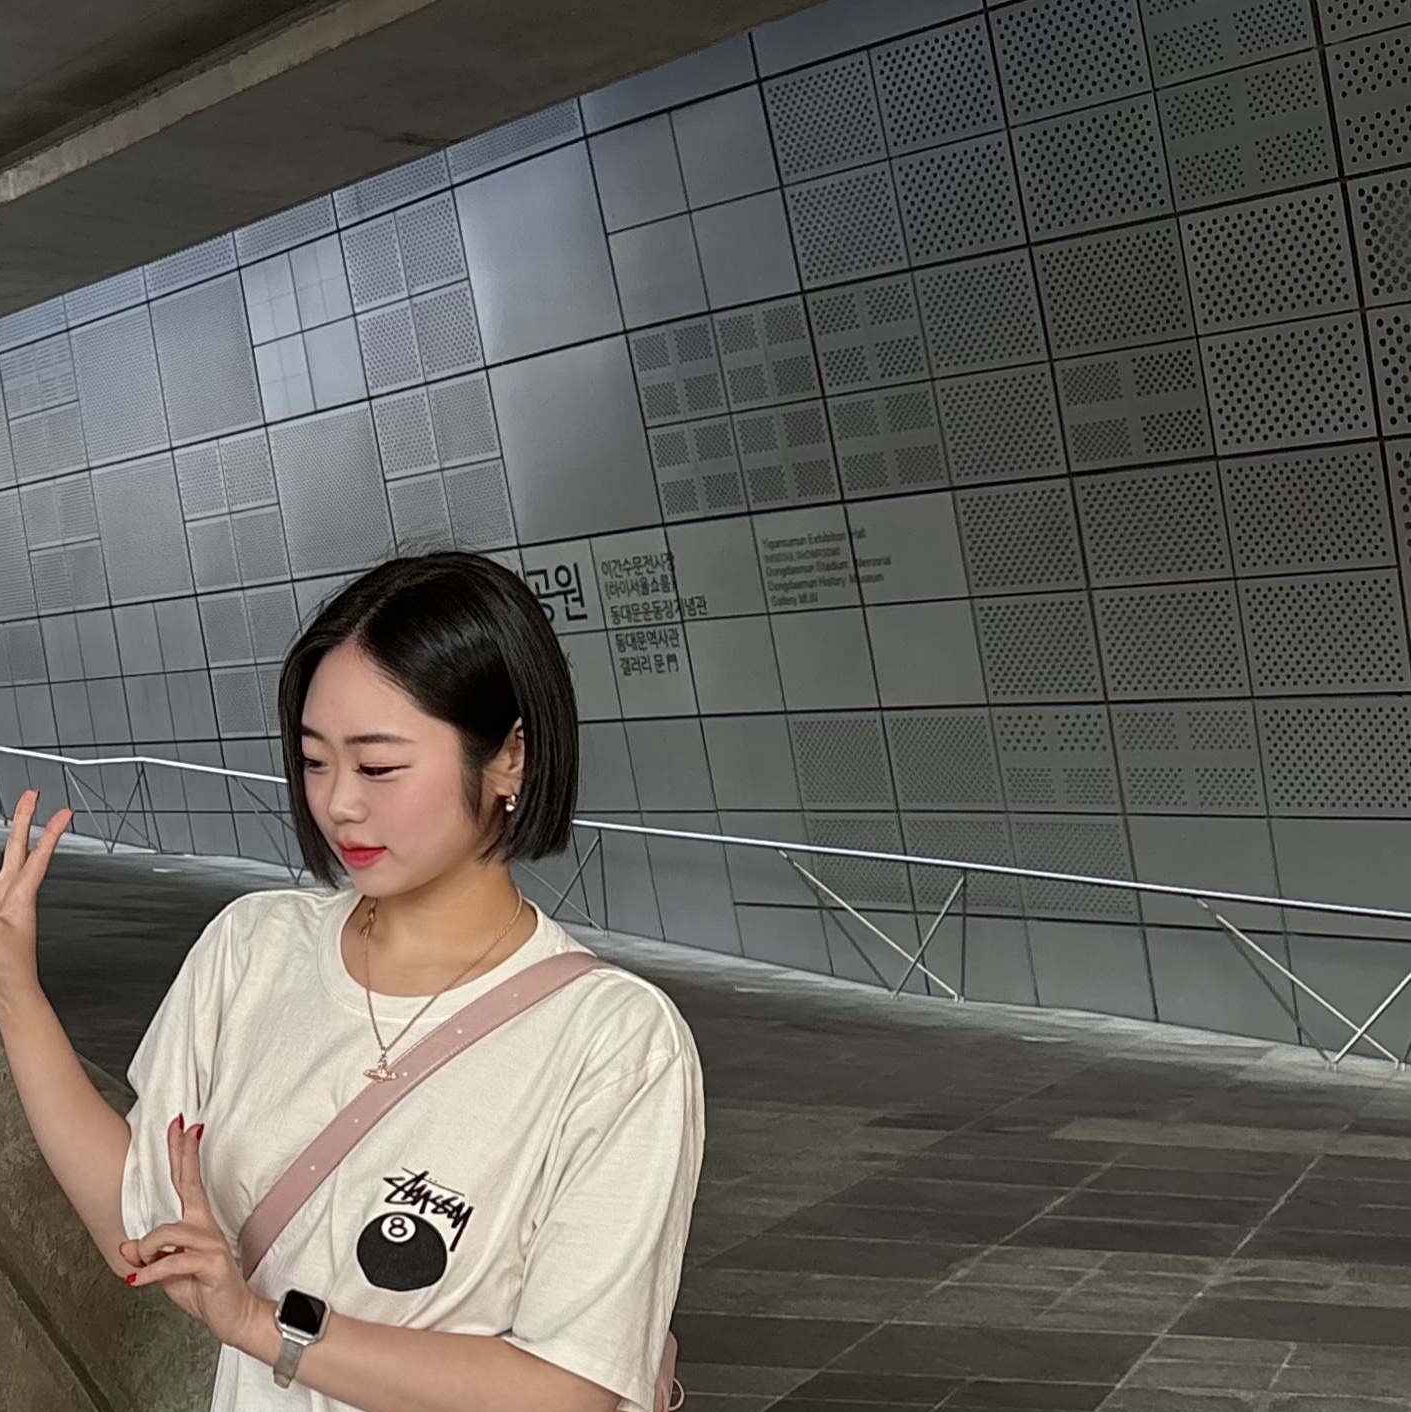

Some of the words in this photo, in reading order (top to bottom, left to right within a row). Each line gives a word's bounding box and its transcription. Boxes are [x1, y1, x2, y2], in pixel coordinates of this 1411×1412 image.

[524, 562, 588, 624] 공원
[619, 653, 652, 677] 갤러리
[389, 1216, 408, 1239] 8
